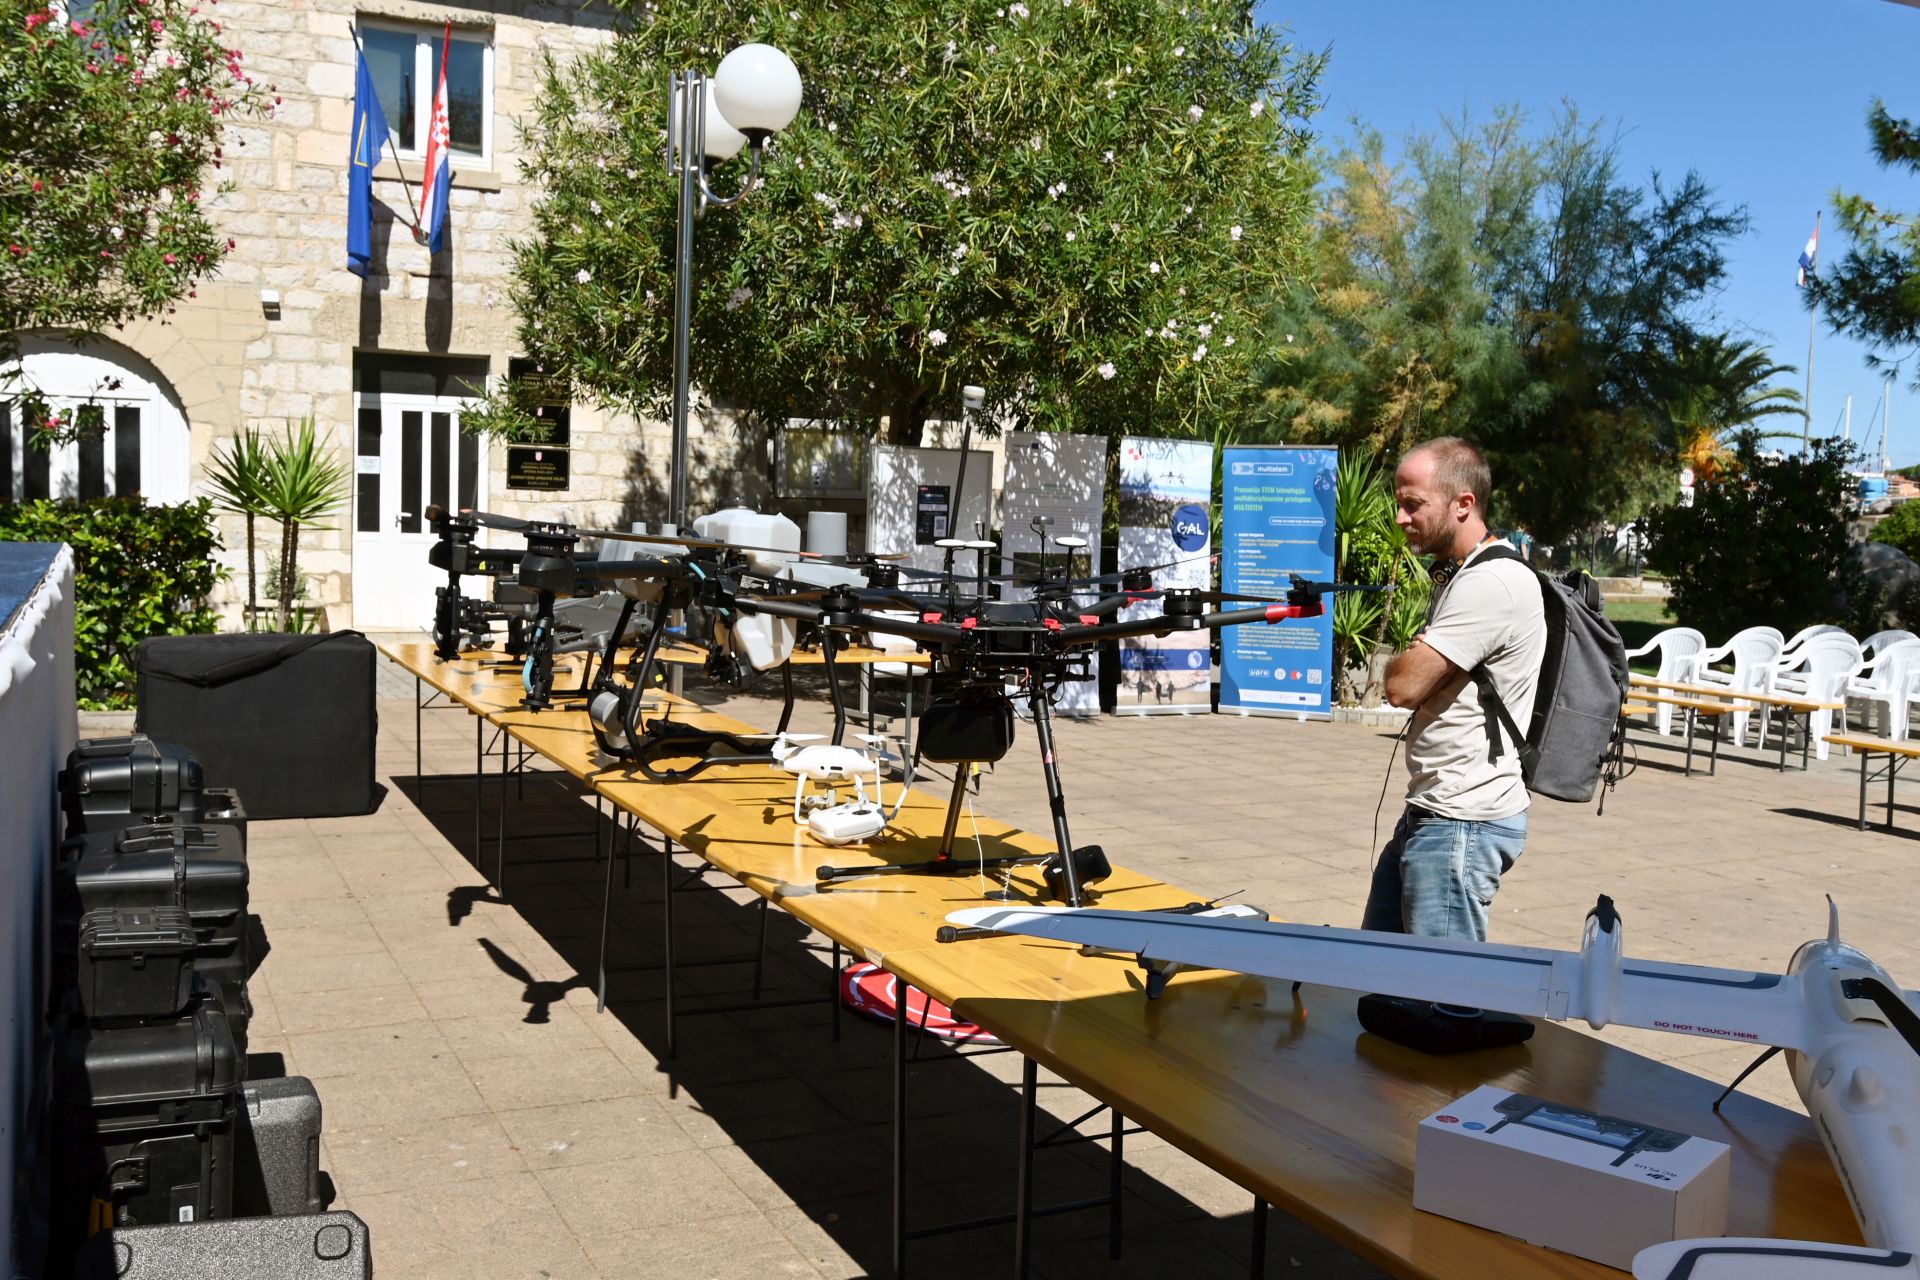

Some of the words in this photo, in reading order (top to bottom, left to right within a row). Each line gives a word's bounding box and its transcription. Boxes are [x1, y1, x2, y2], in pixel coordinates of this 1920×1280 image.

[1177, 521, 1205, 535] GAL
[1672, 1023, 1694, 1031] NOT
[1696, 1026, 1730, 1036] TOUCH
[1733, 1032, 1758, 1040] HERE
